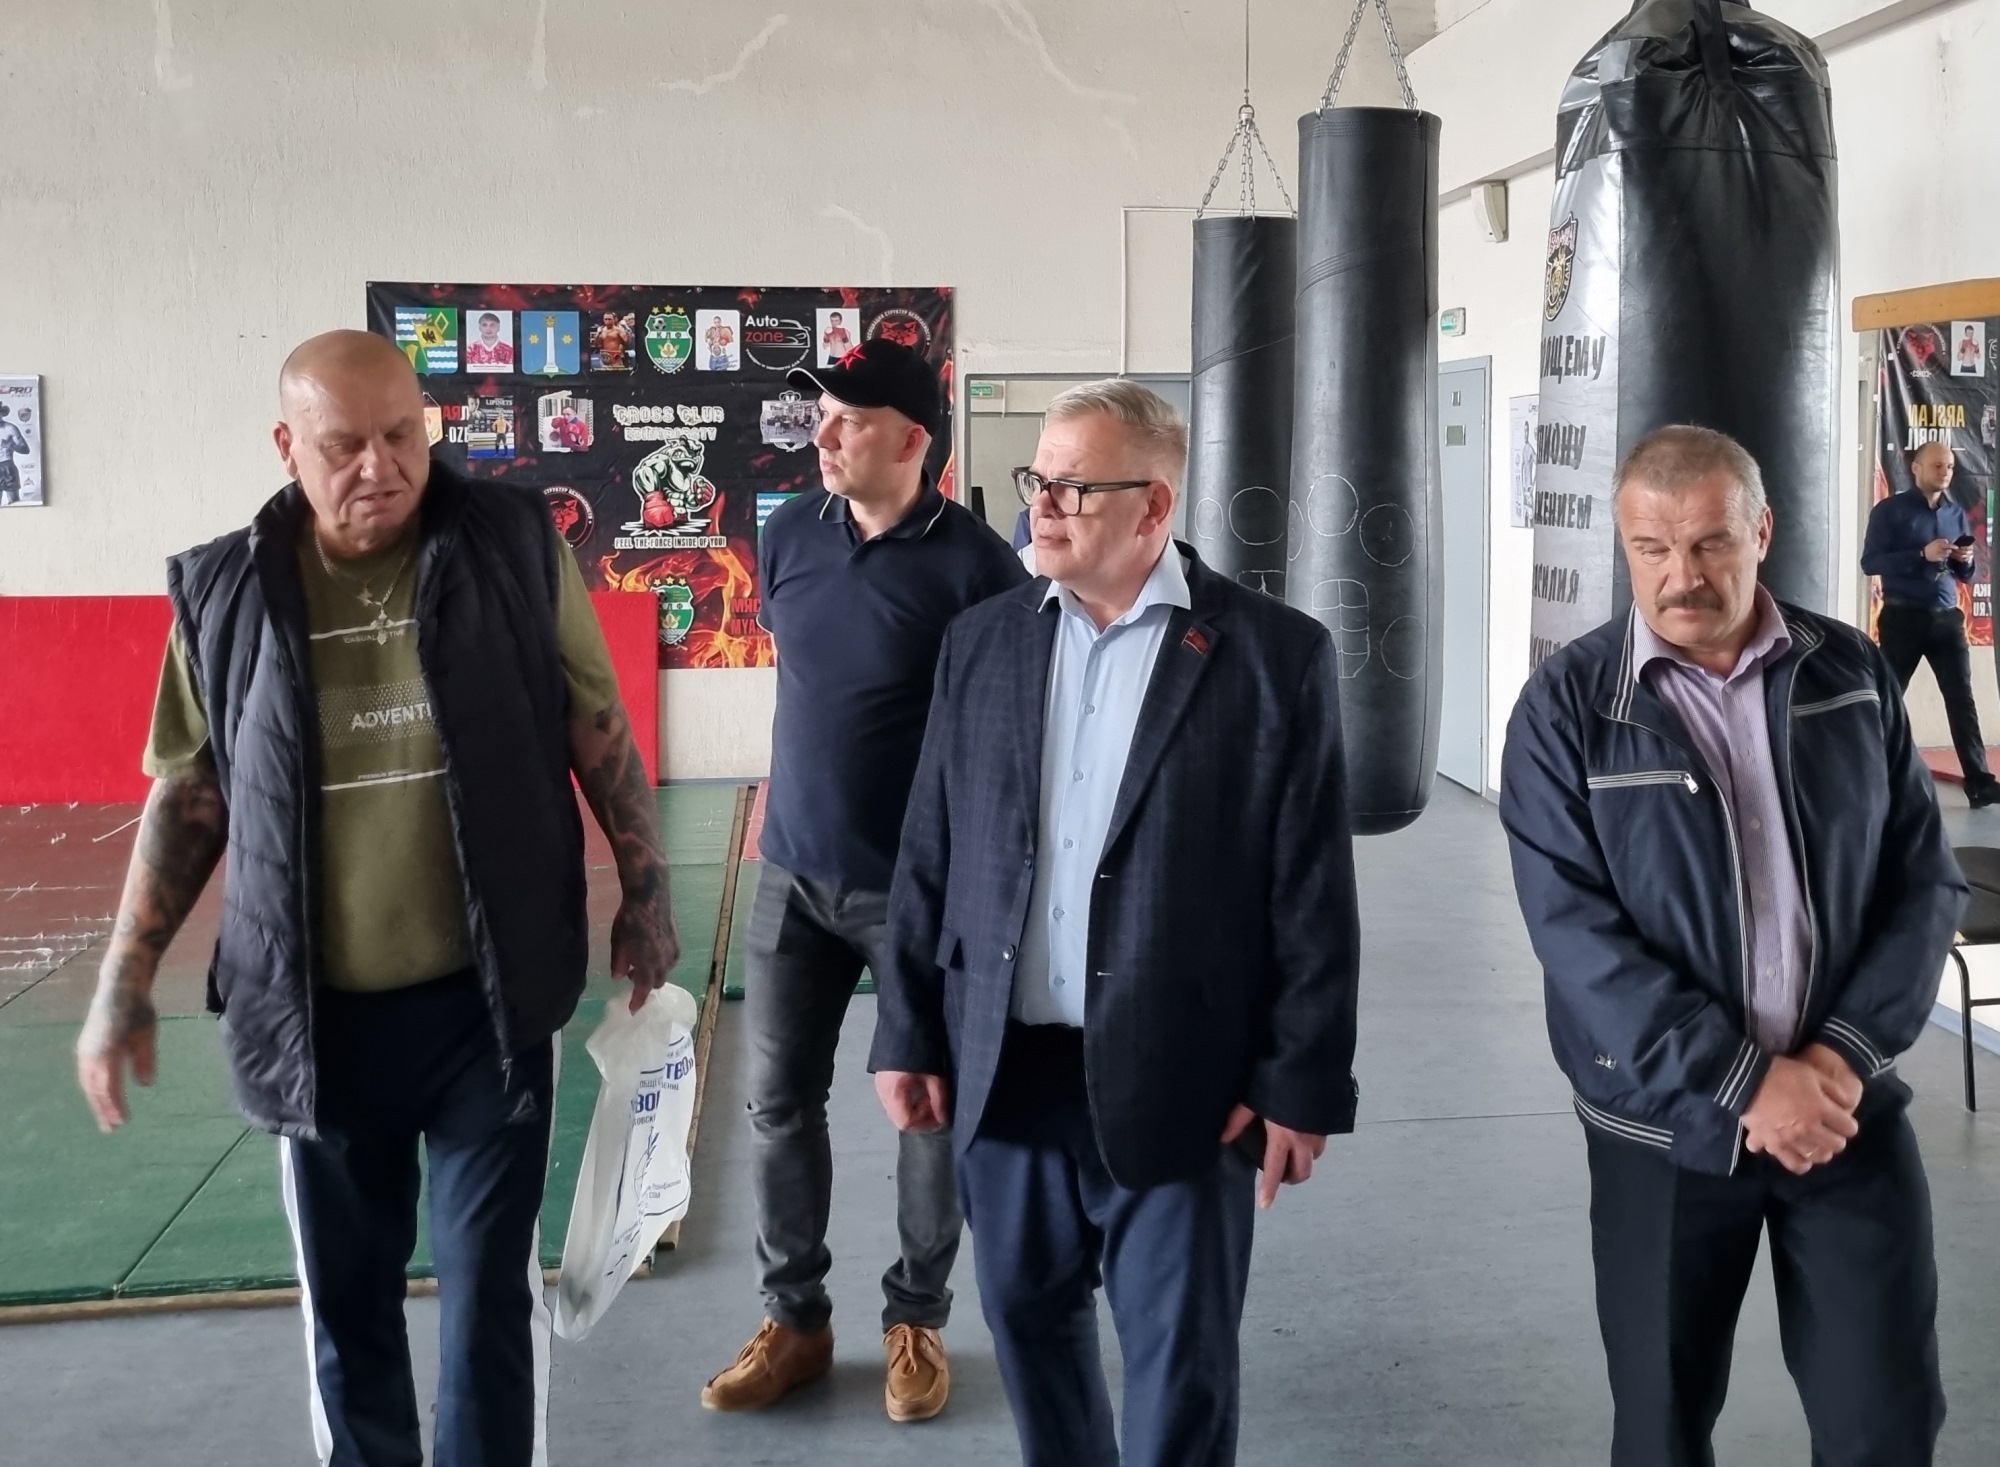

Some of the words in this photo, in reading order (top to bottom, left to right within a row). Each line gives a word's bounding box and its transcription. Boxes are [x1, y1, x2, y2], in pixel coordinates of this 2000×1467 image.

[745, 315, 779, 327] Auto
[745, 331, 784, 343] zone
[613, 404, 675, 426] CROSS
[677, 404, 724, 426] CLUB
[1537, 422, 1586, 470] ПИОНУ
[615, 537, 633, 549] FEEL
[634, 537, 649, 549] THE
[649, 537, 672, 549] FORCE
[673, 536, 697, 549] INSIDE
[698, 537, 708, 548] OF
[731, 598, 761, 613] МЯС
[343, 633, 377, 644] CASUAL
